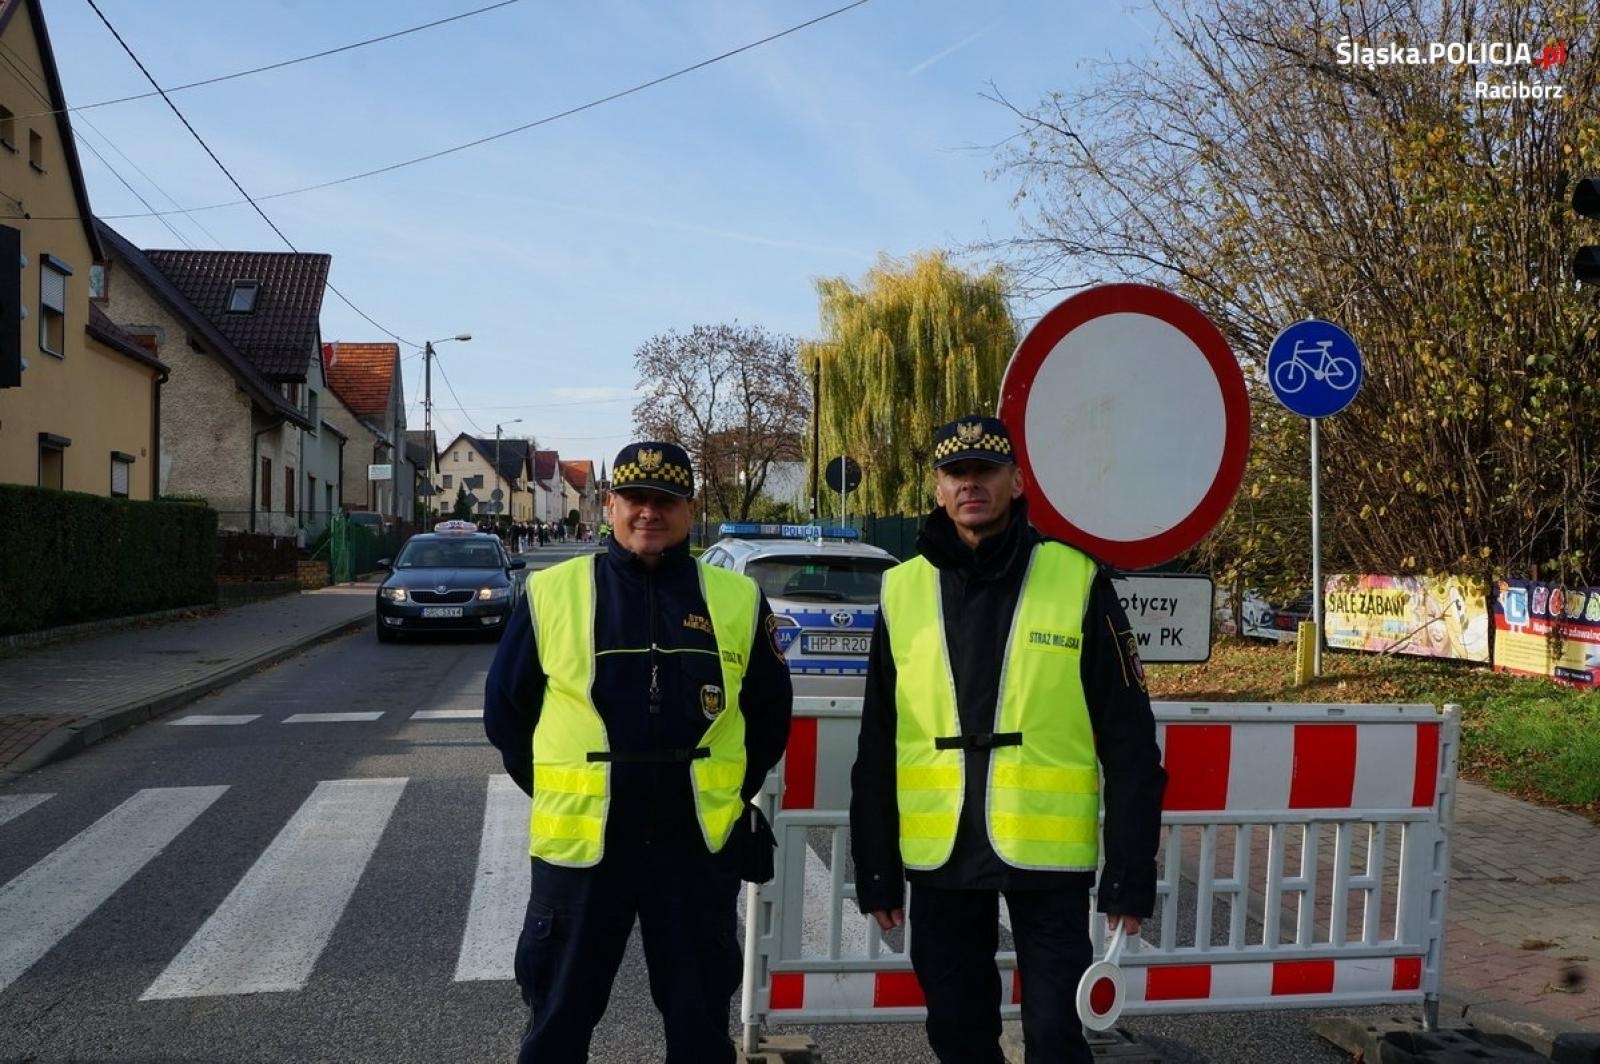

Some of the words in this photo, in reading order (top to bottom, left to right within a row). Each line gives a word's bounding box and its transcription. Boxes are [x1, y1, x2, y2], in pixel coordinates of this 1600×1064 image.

[783, 526, 820, 537] POLICJA
[1120, 593, 1178, 616] otyczy
[1359, 593, 1405, 616] ZABAW
[811, 637, 838, 651] HPP
[842, 637, 868, 651] R20
[1137, 634, 1151, 646] w
[1160, 628, 1183, 646] PK
